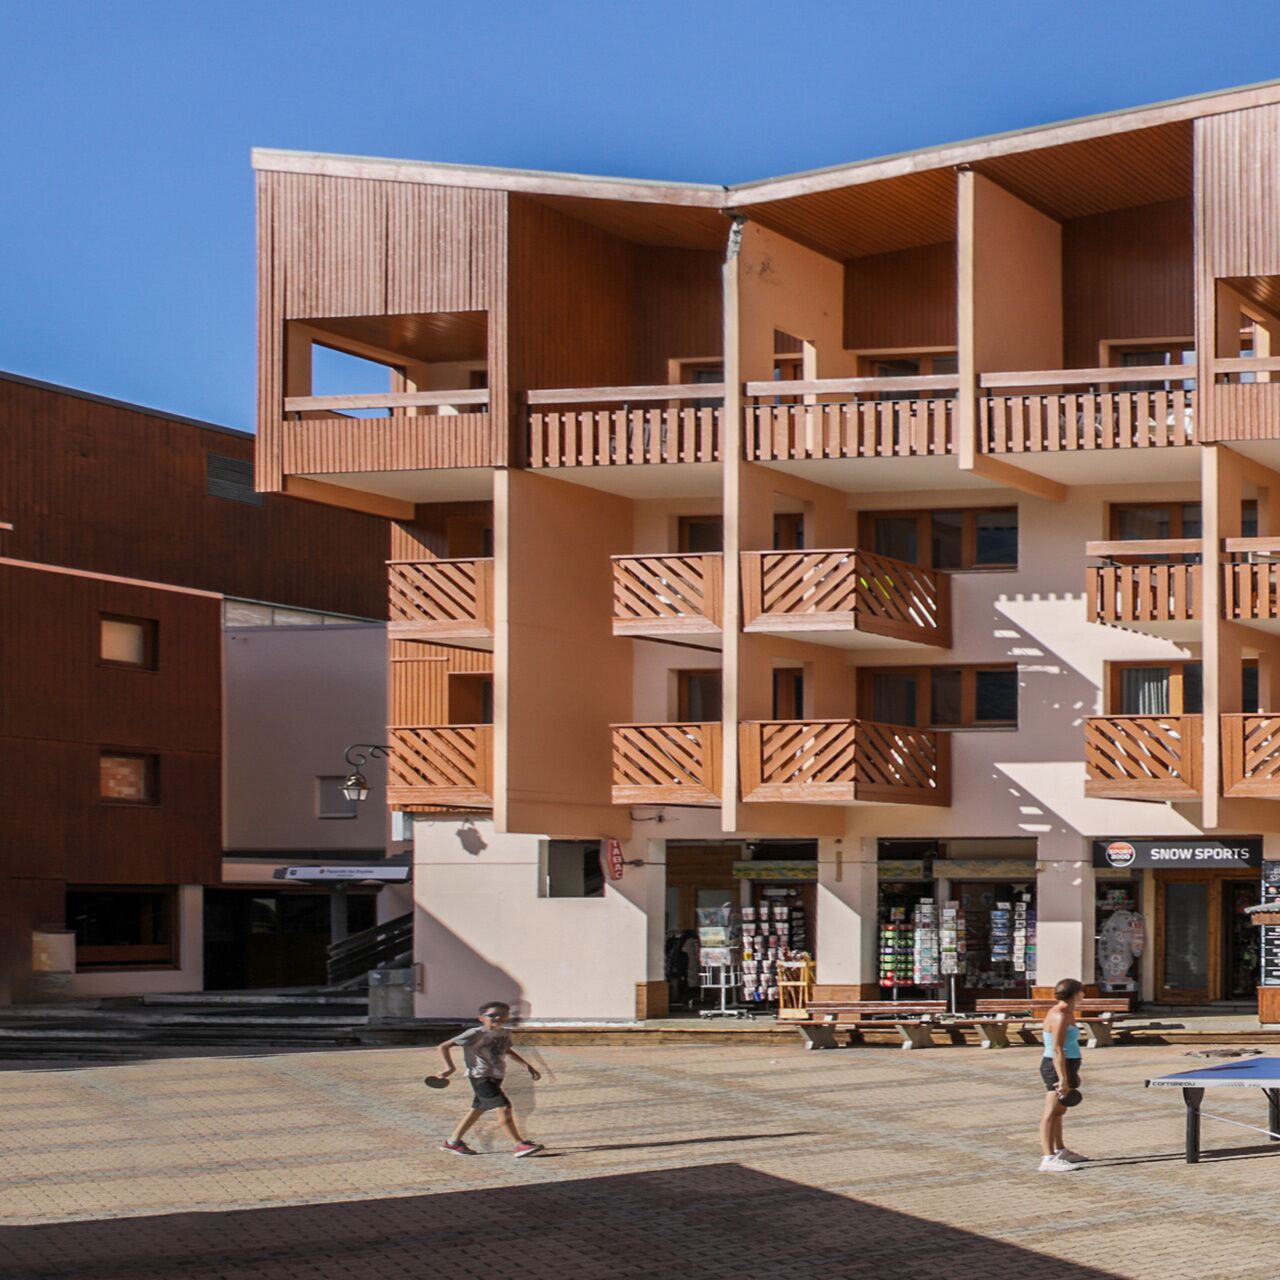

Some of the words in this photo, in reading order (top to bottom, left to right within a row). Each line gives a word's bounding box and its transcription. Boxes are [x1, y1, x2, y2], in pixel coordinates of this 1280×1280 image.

[611, 840, 622, 879] TABAC
[1150, 848, 1193, 860] SNOW
[1194, 847, 1250, 860] SPORTS
